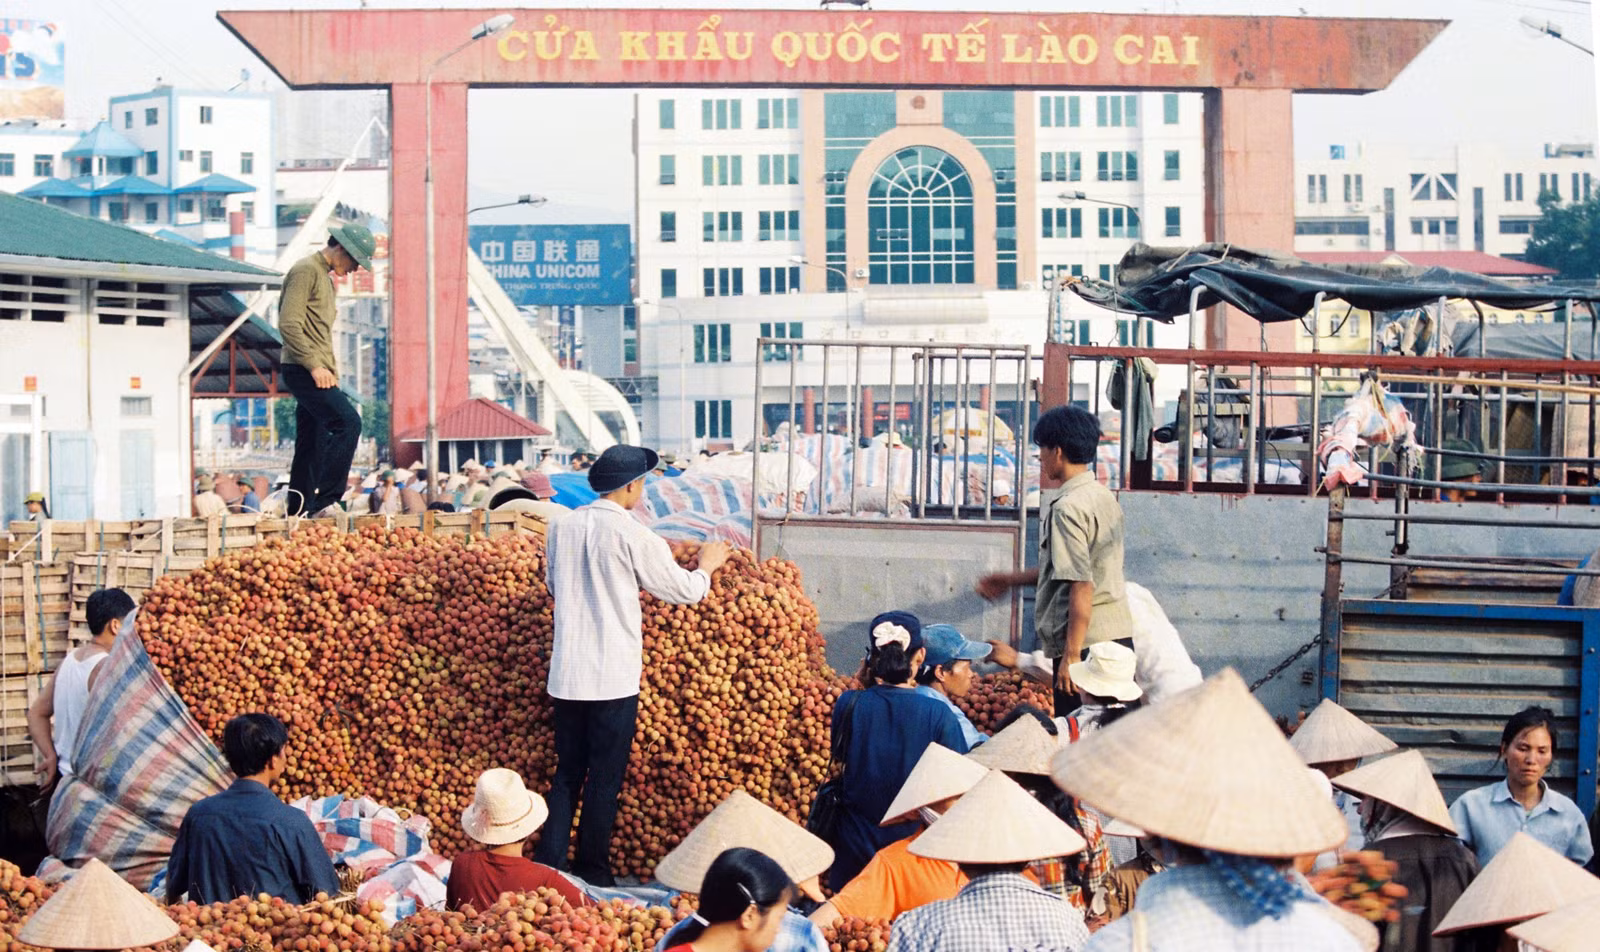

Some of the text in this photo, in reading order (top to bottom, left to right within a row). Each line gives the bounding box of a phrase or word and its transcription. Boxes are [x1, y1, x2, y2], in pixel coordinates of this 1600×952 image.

[498, 14, 1199, 67] CỬA KHẨU QUỐC TẾ LÀO CAI
[481, 240, 599, 262] 中国联通
[536, 264, 599, 278] UNICOM
